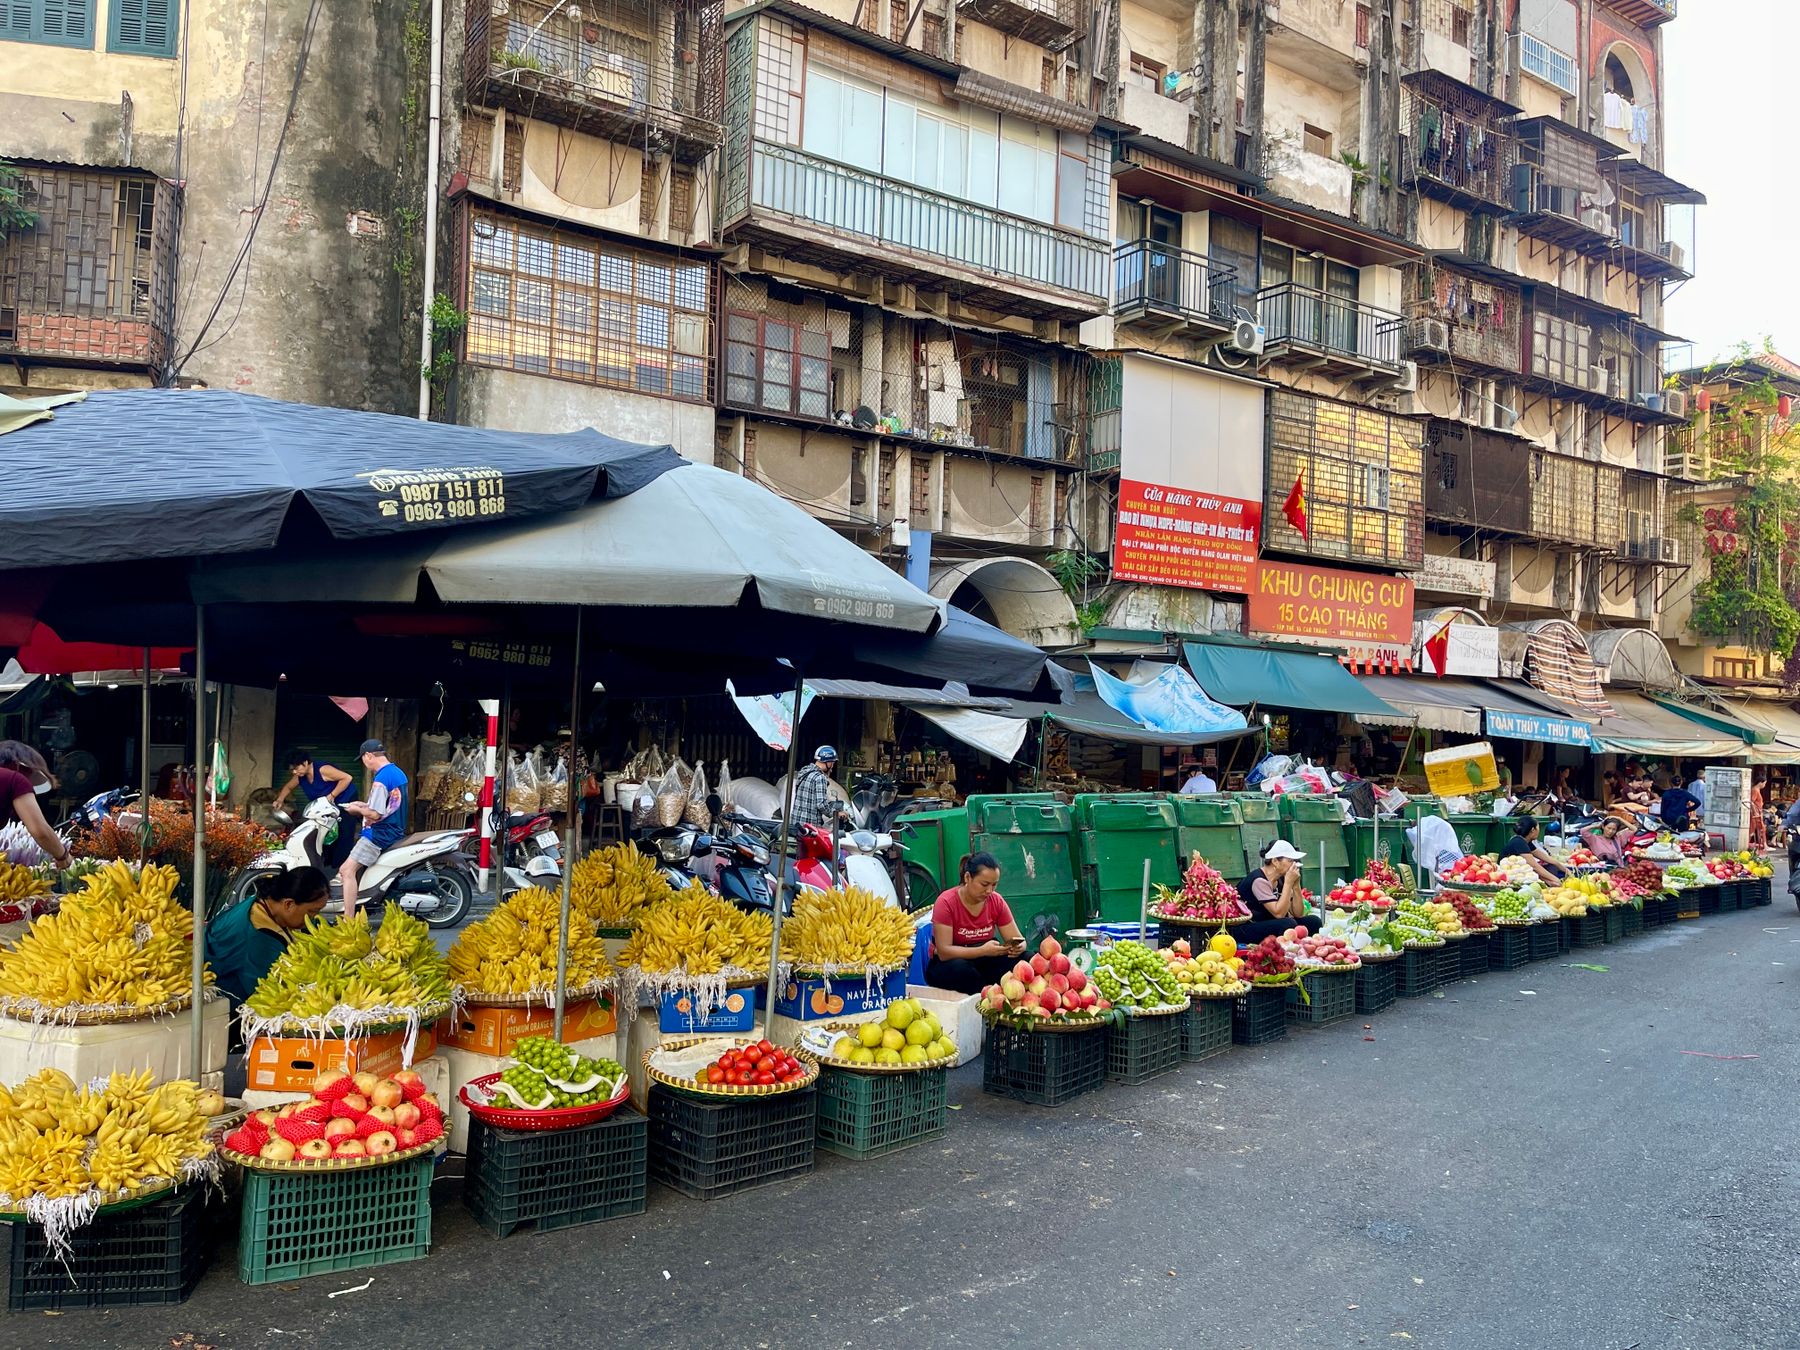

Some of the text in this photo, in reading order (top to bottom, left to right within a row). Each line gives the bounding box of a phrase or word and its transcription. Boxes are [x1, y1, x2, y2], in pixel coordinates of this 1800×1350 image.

[400, 483, 440, 502] 0987
[444, 480, 472, 499] 151
[478, 478, 504, 496] 811
[1144, 486, 1164, 502] CỬA
[1166, 490, 1192, 506] HÀNG
[1222, 502, 1244, 514] ANH
[404, 496, 505, 522] 0962 980 868
[1260, 568, 1302, 597] KHU
[1308, 574, 1374, 604] CHUNG
[1380, 582, 1406, 608] CƯ
[827, 598, 894, 619] 0962 980 868
[1278, 602, 1388, 630] 15 CAO THẮNG
[469, 646, 551, 667] 0962 980 868
[1490, 714, 1514, 732] TOÀN
[847, 988, 878, 1000] NAVEL
